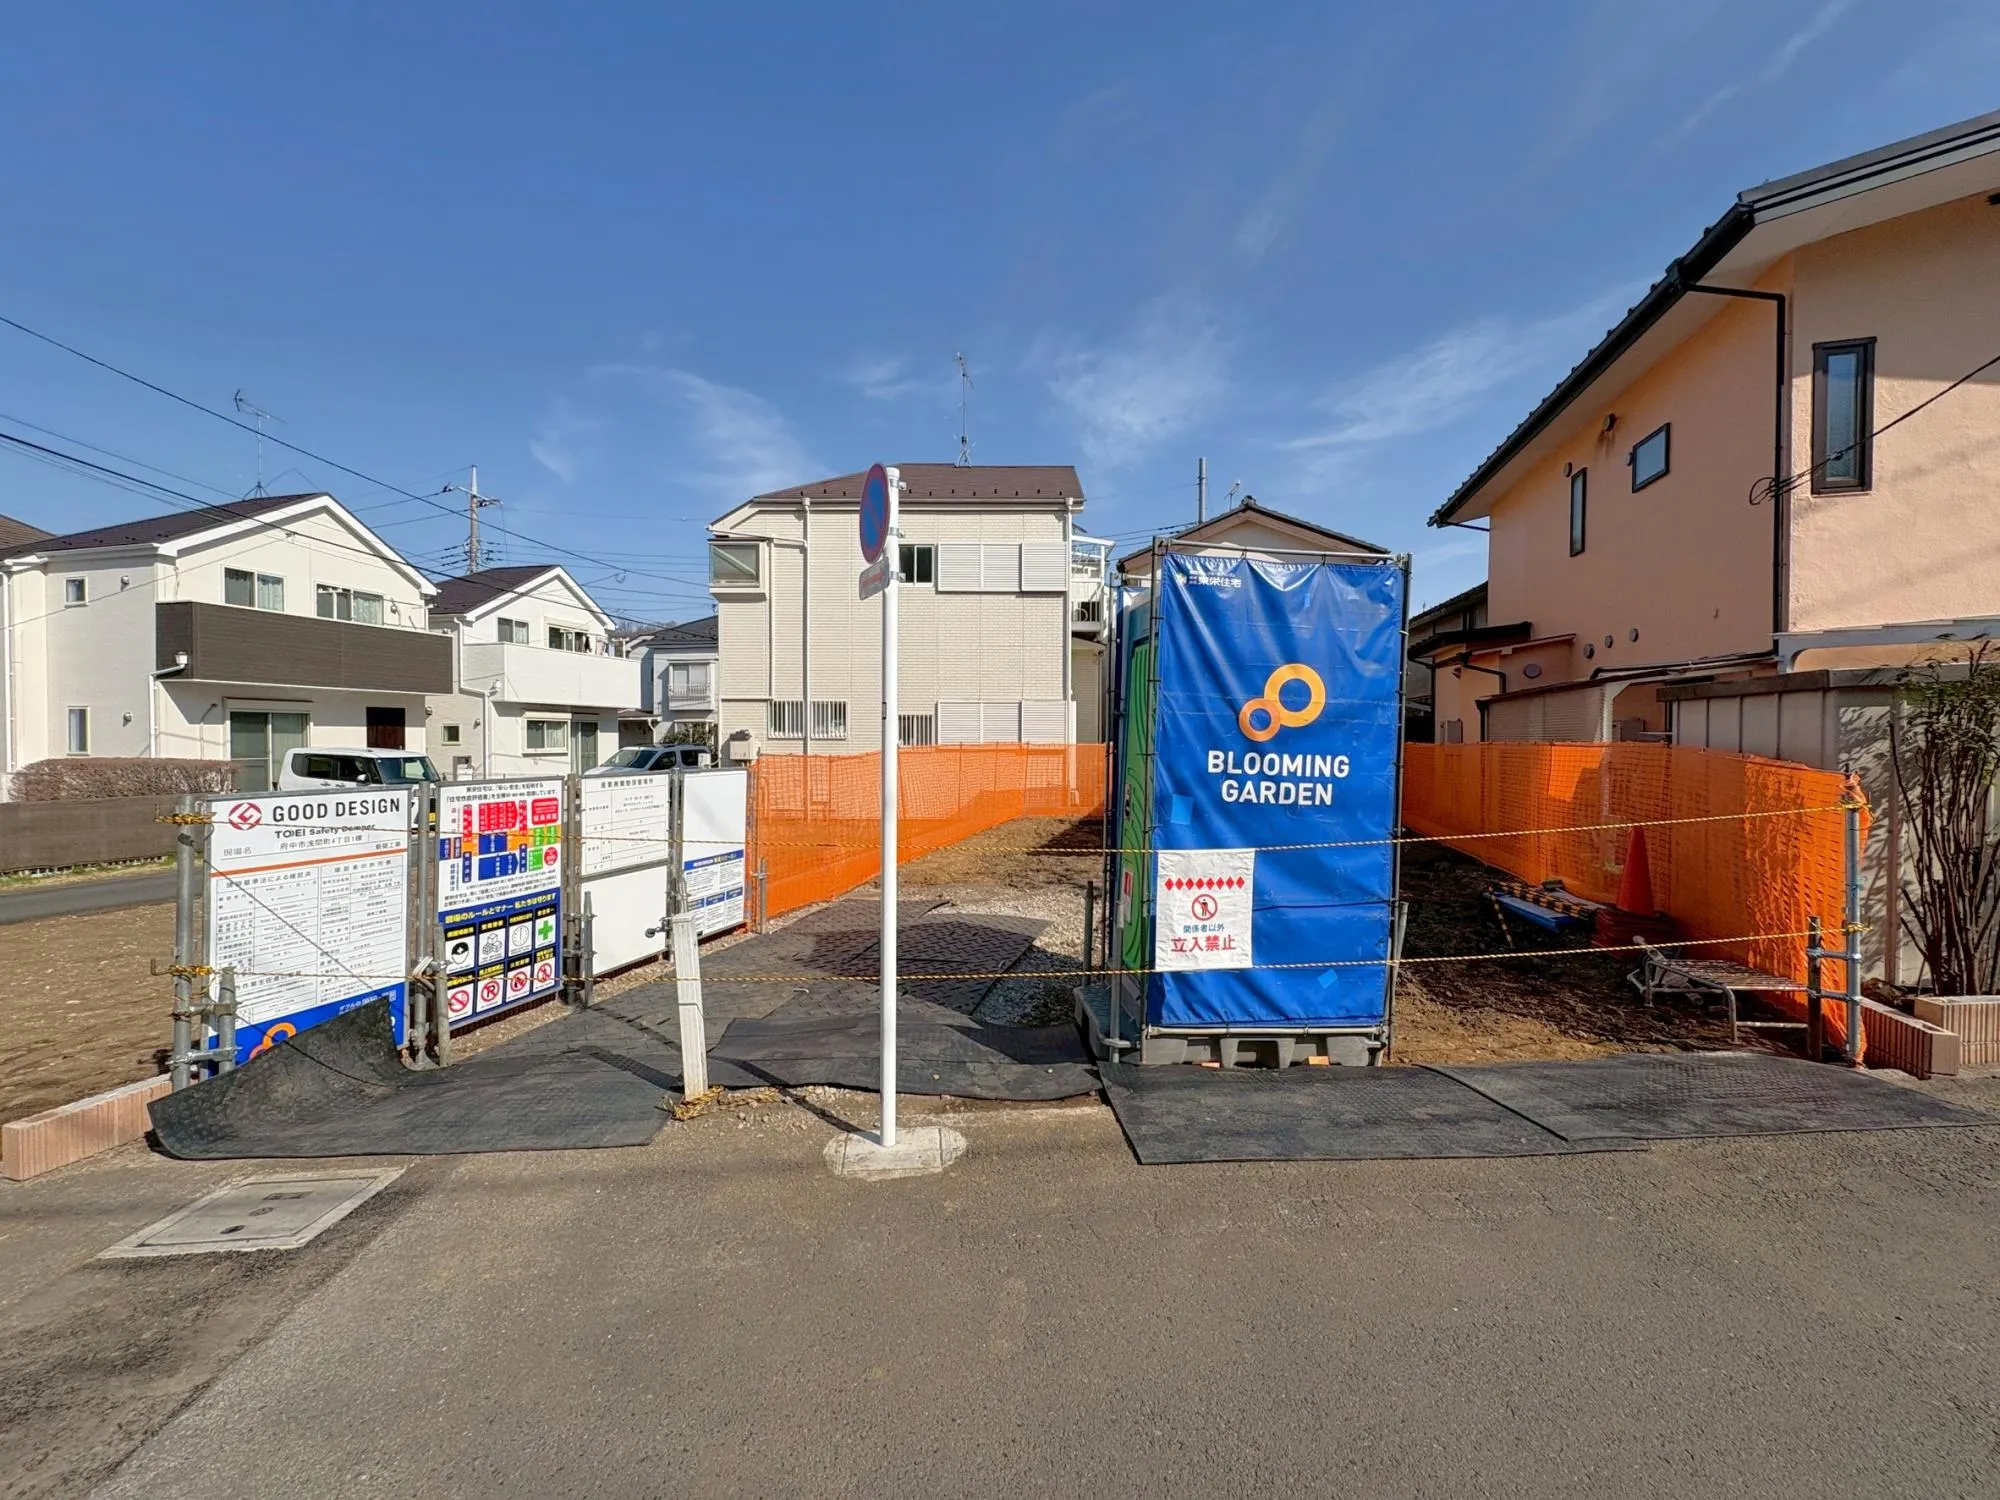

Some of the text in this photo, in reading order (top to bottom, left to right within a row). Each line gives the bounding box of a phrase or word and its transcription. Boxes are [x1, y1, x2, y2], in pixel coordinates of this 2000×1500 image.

[1207, 750, 1350, 778] BLOOMING
[1221, 780, 1333, 806] GARDEN
[273, 798, 400, 822] GOOD DESIGN
[309, 827, 339, 835] Safety
[1183, 923, 1225, 933] 関係者以外
[1171, 934, 1237, 952] 立入禁止
